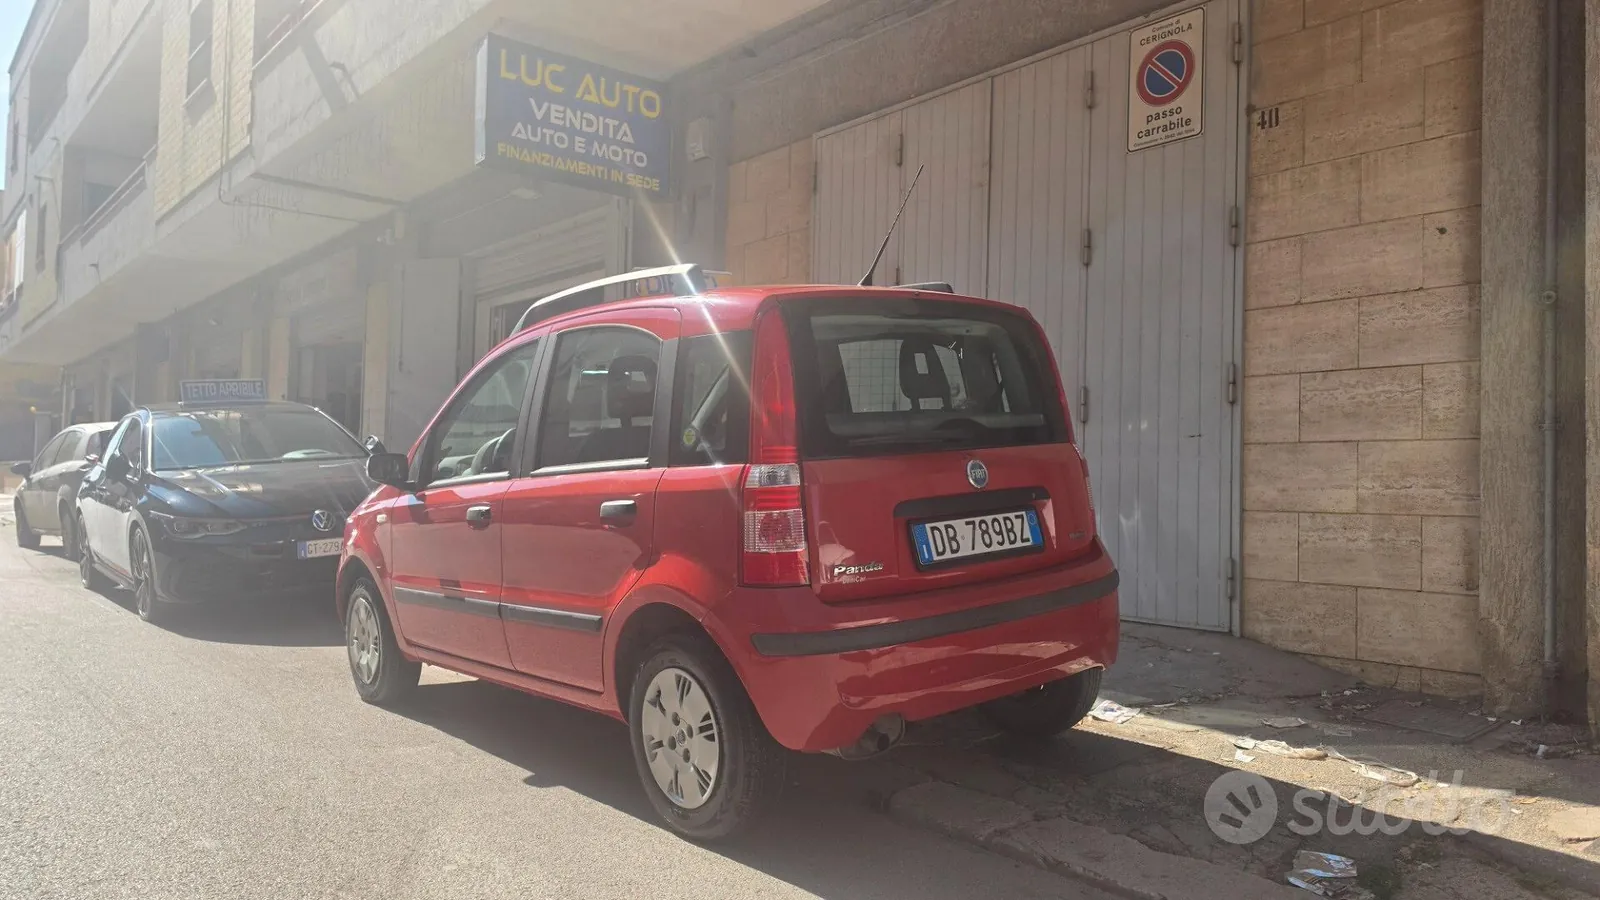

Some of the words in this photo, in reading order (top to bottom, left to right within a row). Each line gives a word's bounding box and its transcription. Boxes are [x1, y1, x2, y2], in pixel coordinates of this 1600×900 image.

[1139, 22, 1193, 47] CERIGNOLA
[500, 48, 566, 93] LUC
[575, 73, 661, 119] AUTO
[529, 97, 635, 144] VENDITA
[1146, 105, 1183, 125] passo
[1137, 117, 1192, 139] carrabile
[511, 121, 569, 149] AUTO
[574, 135, 586, 154] E
[591, 140, 648, 168] MOTO
[498, 142, 608, 179] FINANZIAMENTI
[610, 169, 624, 184] IN
[626, 173, 660, 191] SEDE
[185, 382, 217, 399] TETTO
[219, 382, 263, 397] APRIBILE
[970, 468, 986, 479] FIAT
[929, 525, 961, 558] DB
[965, 513, 1031, 551] 789BZ
[833, 560, 884, 577] Panda
